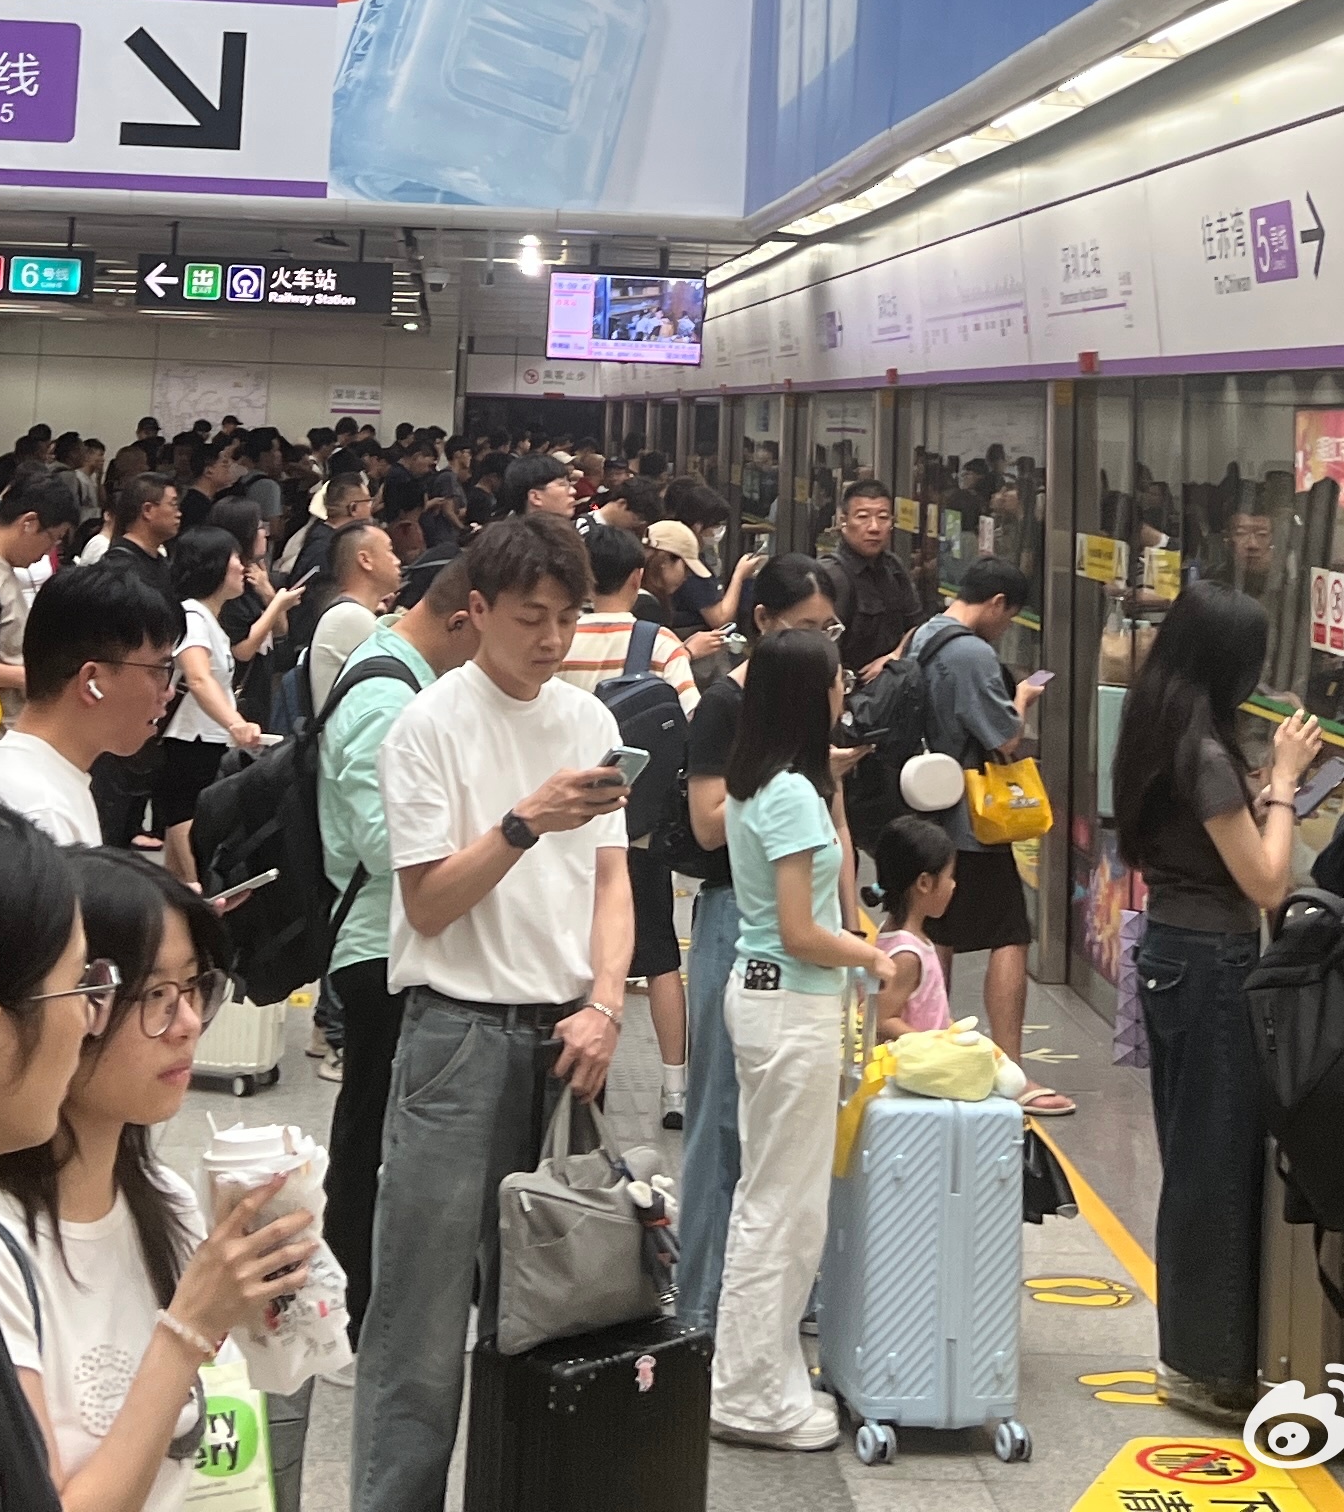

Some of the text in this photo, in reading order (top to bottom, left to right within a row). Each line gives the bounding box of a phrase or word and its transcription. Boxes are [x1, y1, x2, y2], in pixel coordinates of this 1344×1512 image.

[1201, 207, 1246, 264] 往赤湾
[192, 269, 214, 287] 出
[269, 266, 338, 291] 火车站
[268, 292, 356, 307] Railway Station
